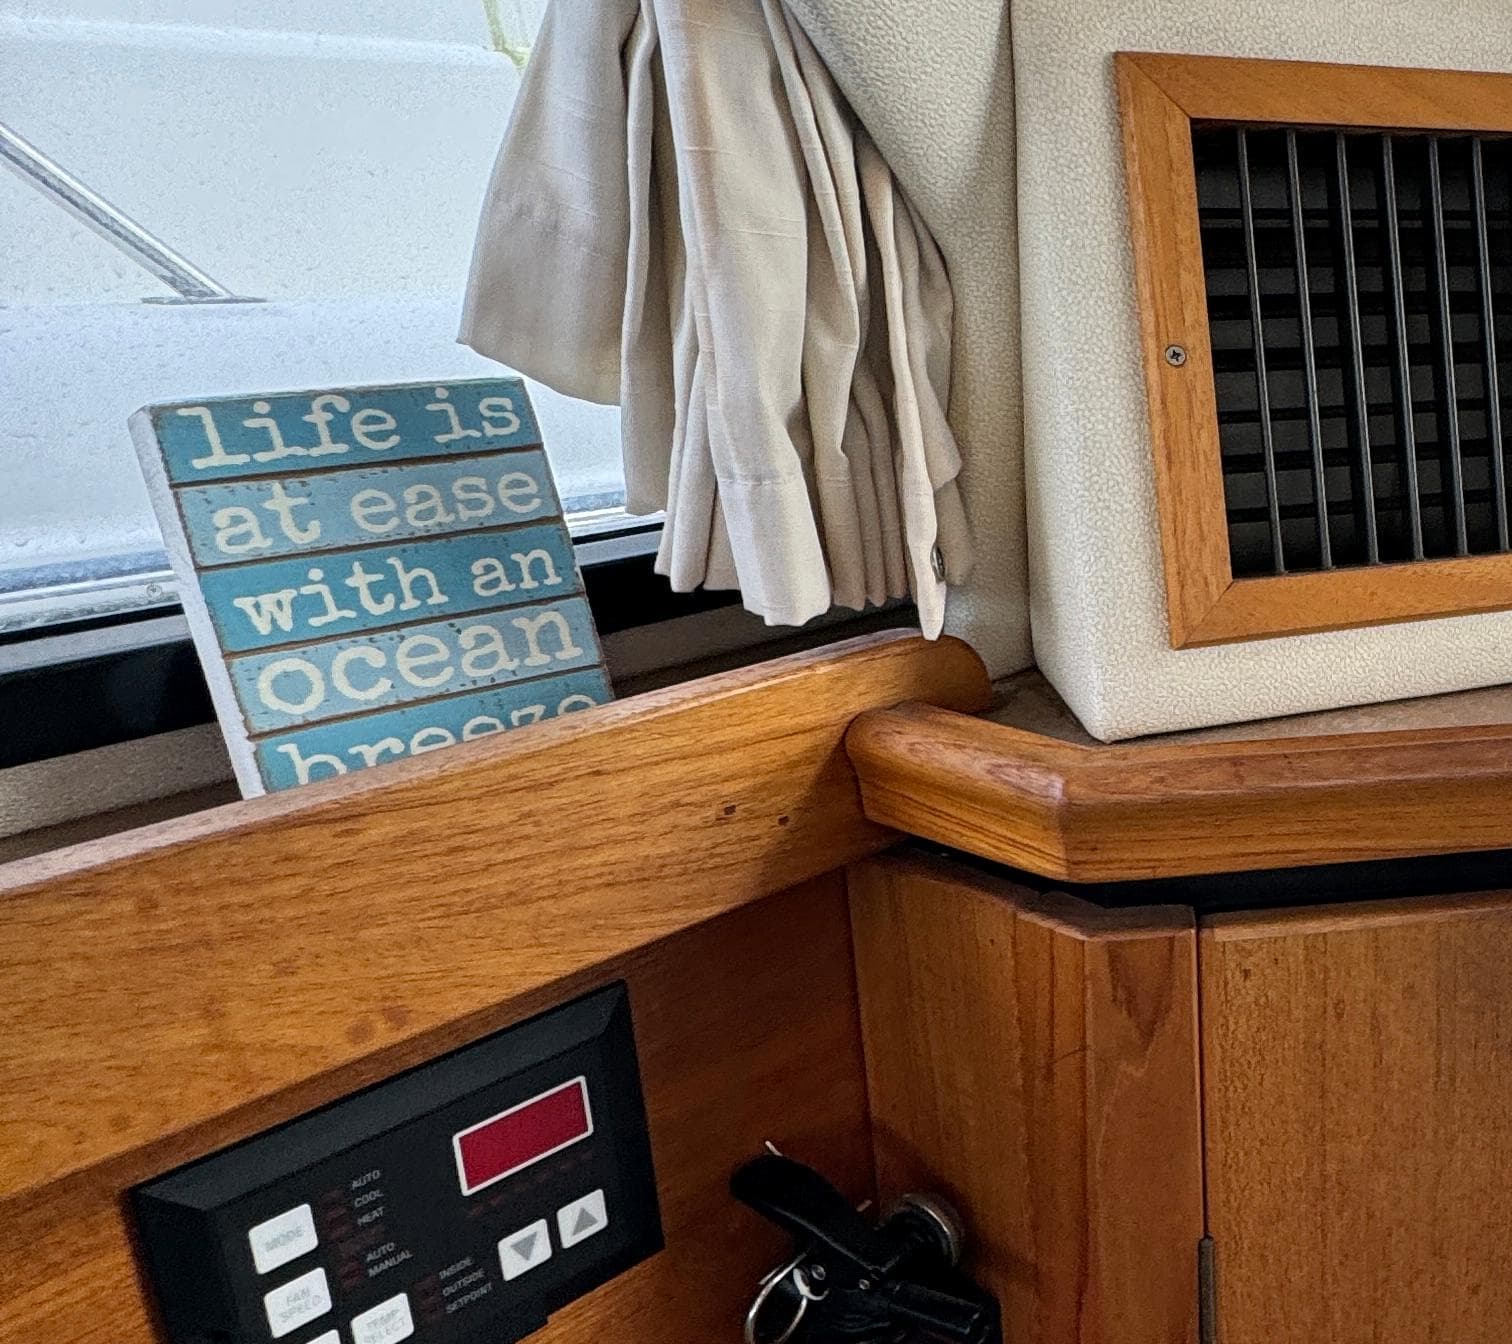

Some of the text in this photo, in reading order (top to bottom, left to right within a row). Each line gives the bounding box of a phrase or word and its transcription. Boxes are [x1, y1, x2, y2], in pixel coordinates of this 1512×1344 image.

[176, 388, 521, 470] life is
[212, 471, 542, 555] at ease
[233, 548, 563, 638] with an
[257, 610, 585, 715] ocean
[352, 1169, 381, 1190] AUTO
[354, 1189, 384, 1208] COOL
[357, 1206, 385, 1226] HEAT
[366, 1242, 395, 1262] AUTO
[368, 1249, 413, 1278] MANUAL
